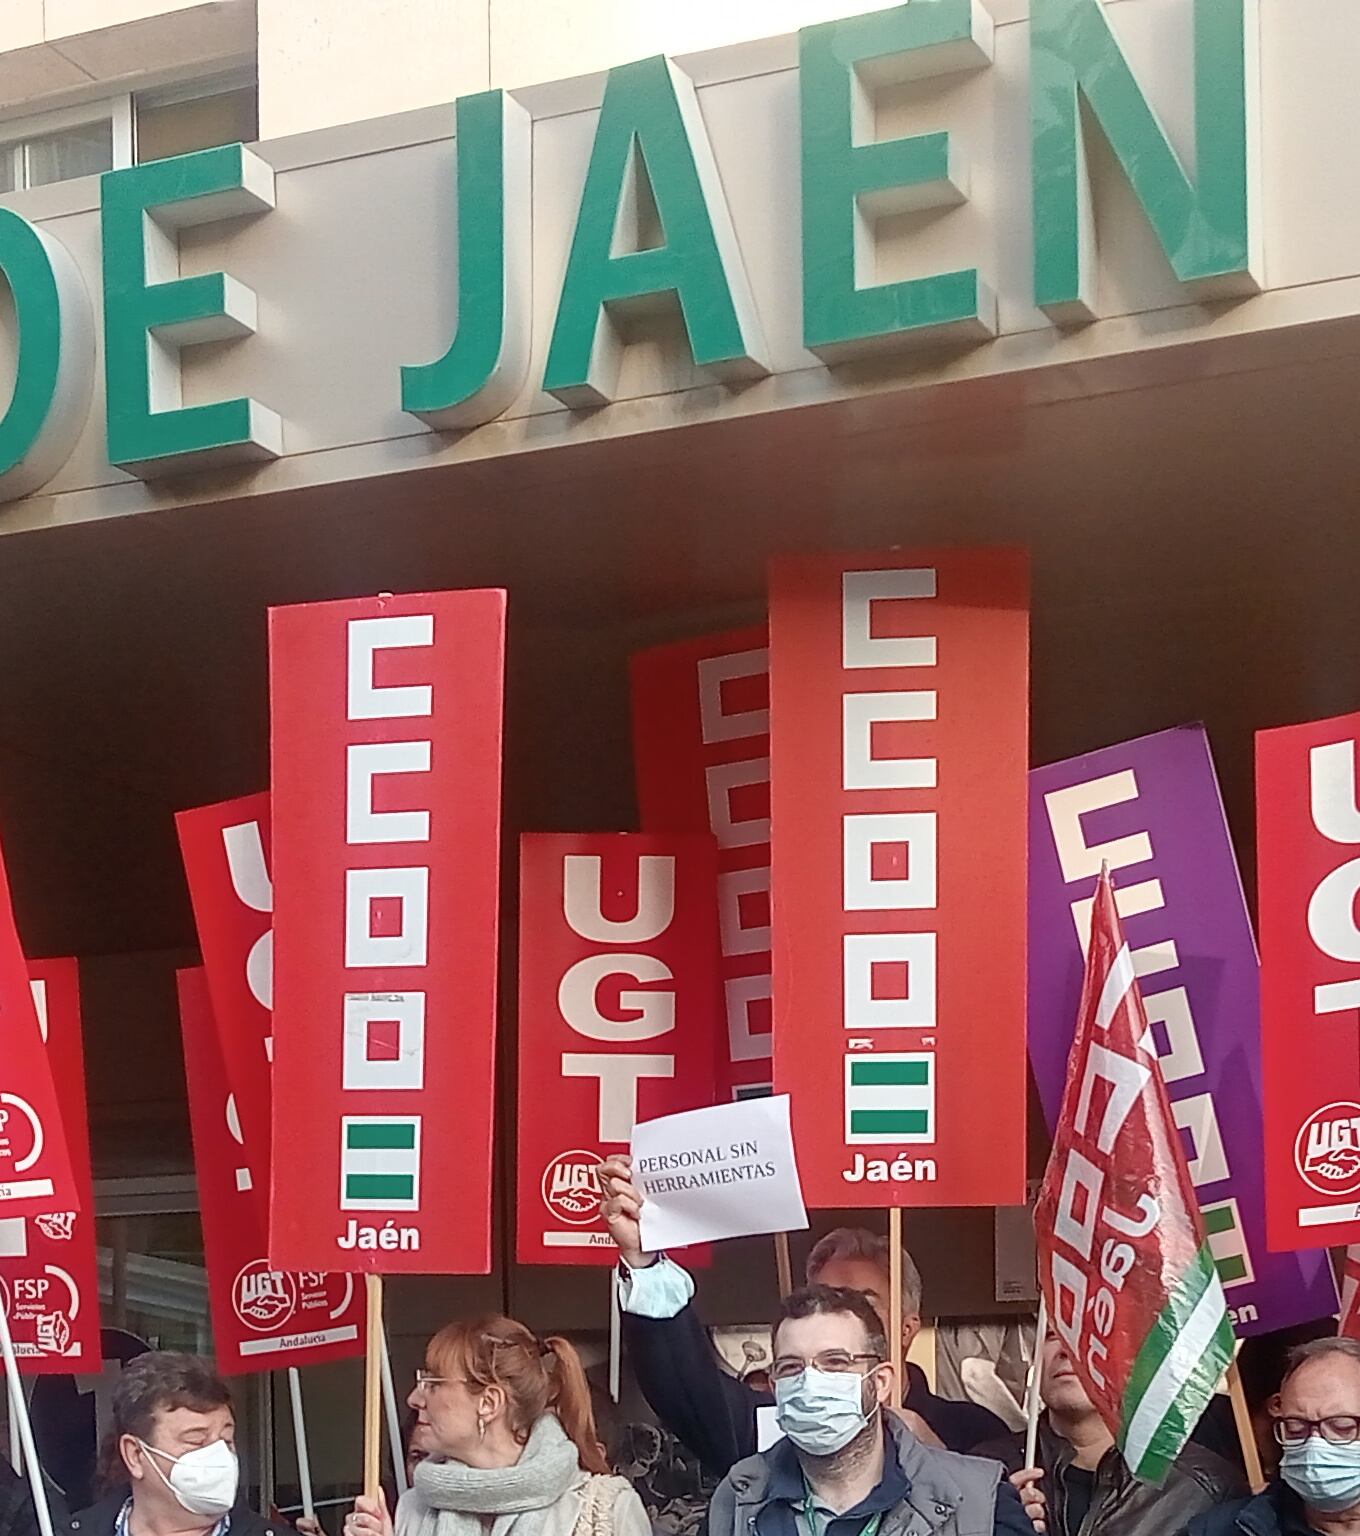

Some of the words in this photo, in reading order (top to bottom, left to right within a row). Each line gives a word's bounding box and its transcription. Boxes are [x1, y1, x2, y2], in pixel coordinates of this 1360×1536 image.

[400, 0, 1250, 413] JAEN
[842, 568, 937, 1030] CCOO
[342, 615, 434, 1090] CCOO
[558, 855, 677, 1143] UGT
[639, 1147, 727, 1174] PERSONAL
[730, 1140, 759, 1158] SIN
[842, 1152, 937, 1184] Jaén
[643, 1162, 776, 1195] HERRAMIENTAS
[337, 1217, 421, 1253] Jaén
[13, 1279, 50, 1299] FSP
